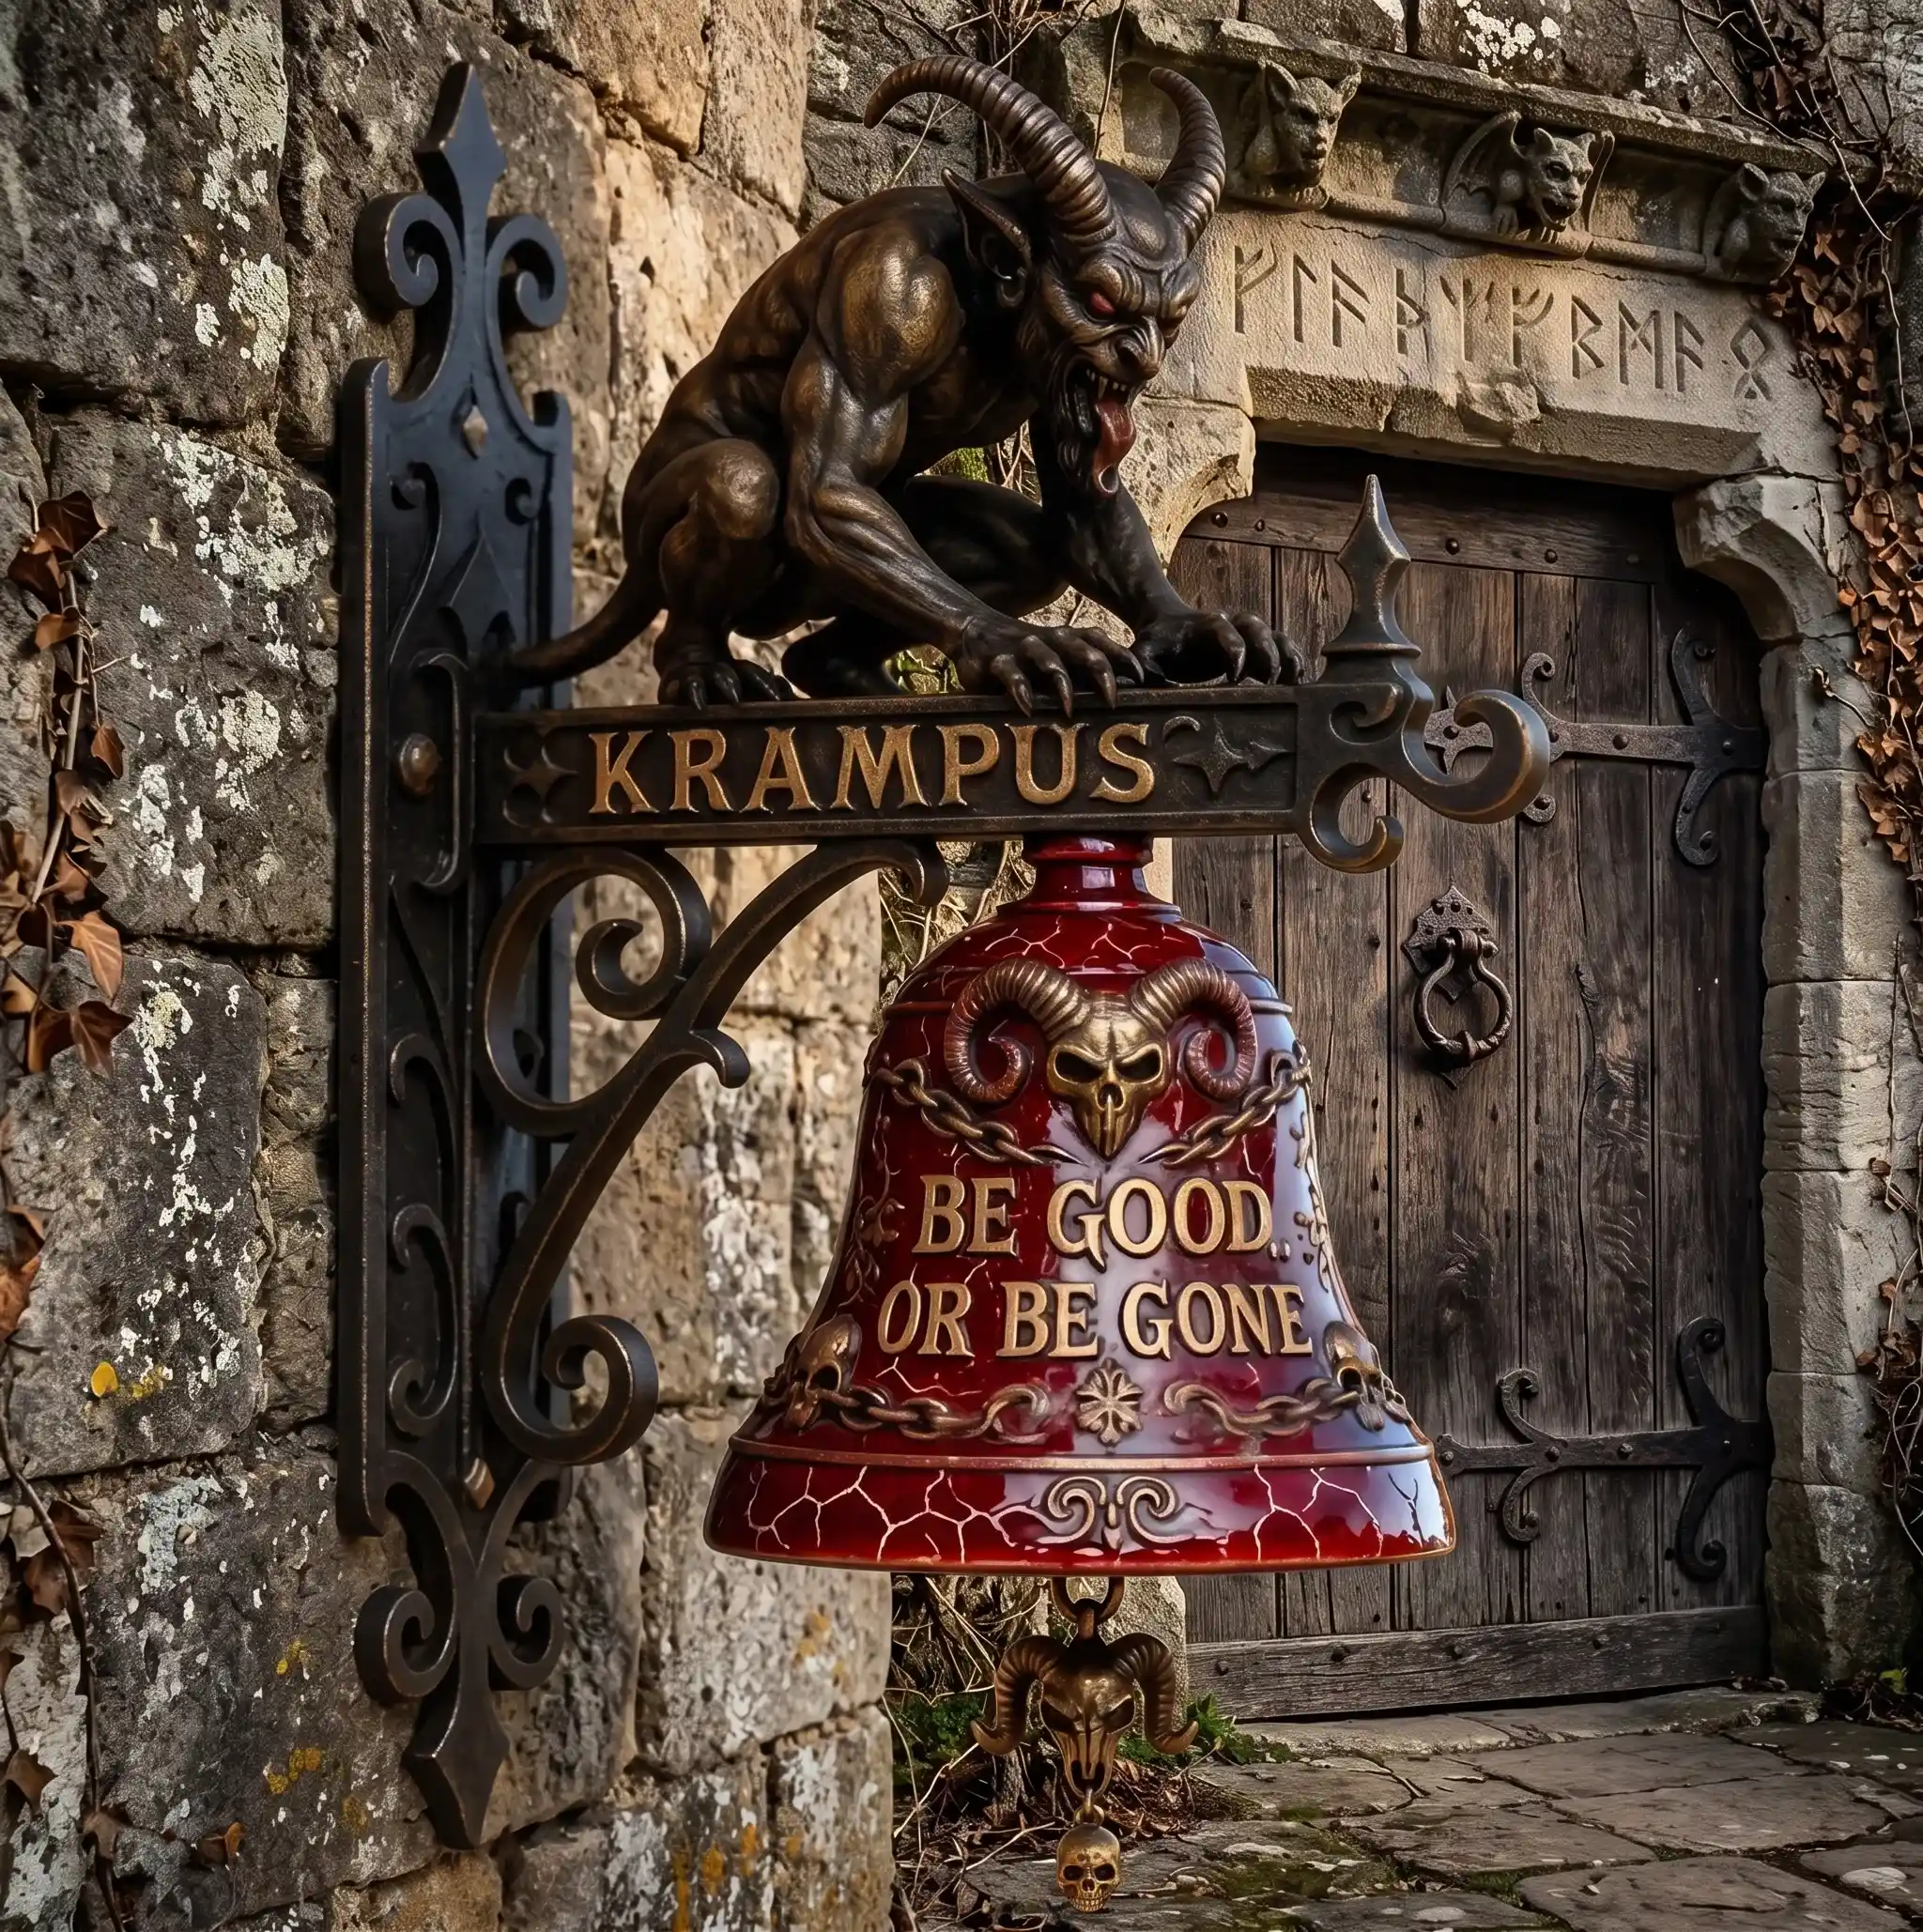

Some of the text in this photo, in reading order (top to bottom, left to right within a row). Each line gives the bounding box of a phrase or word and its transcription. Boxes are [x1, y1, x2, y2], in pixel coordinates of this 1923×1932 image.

[588, 723, 1157, 815] KRAMPUS
[911, 1174, 1274, 1272] BE GOOD
[877, 1279, 1314, 1360] OR BE GONE
